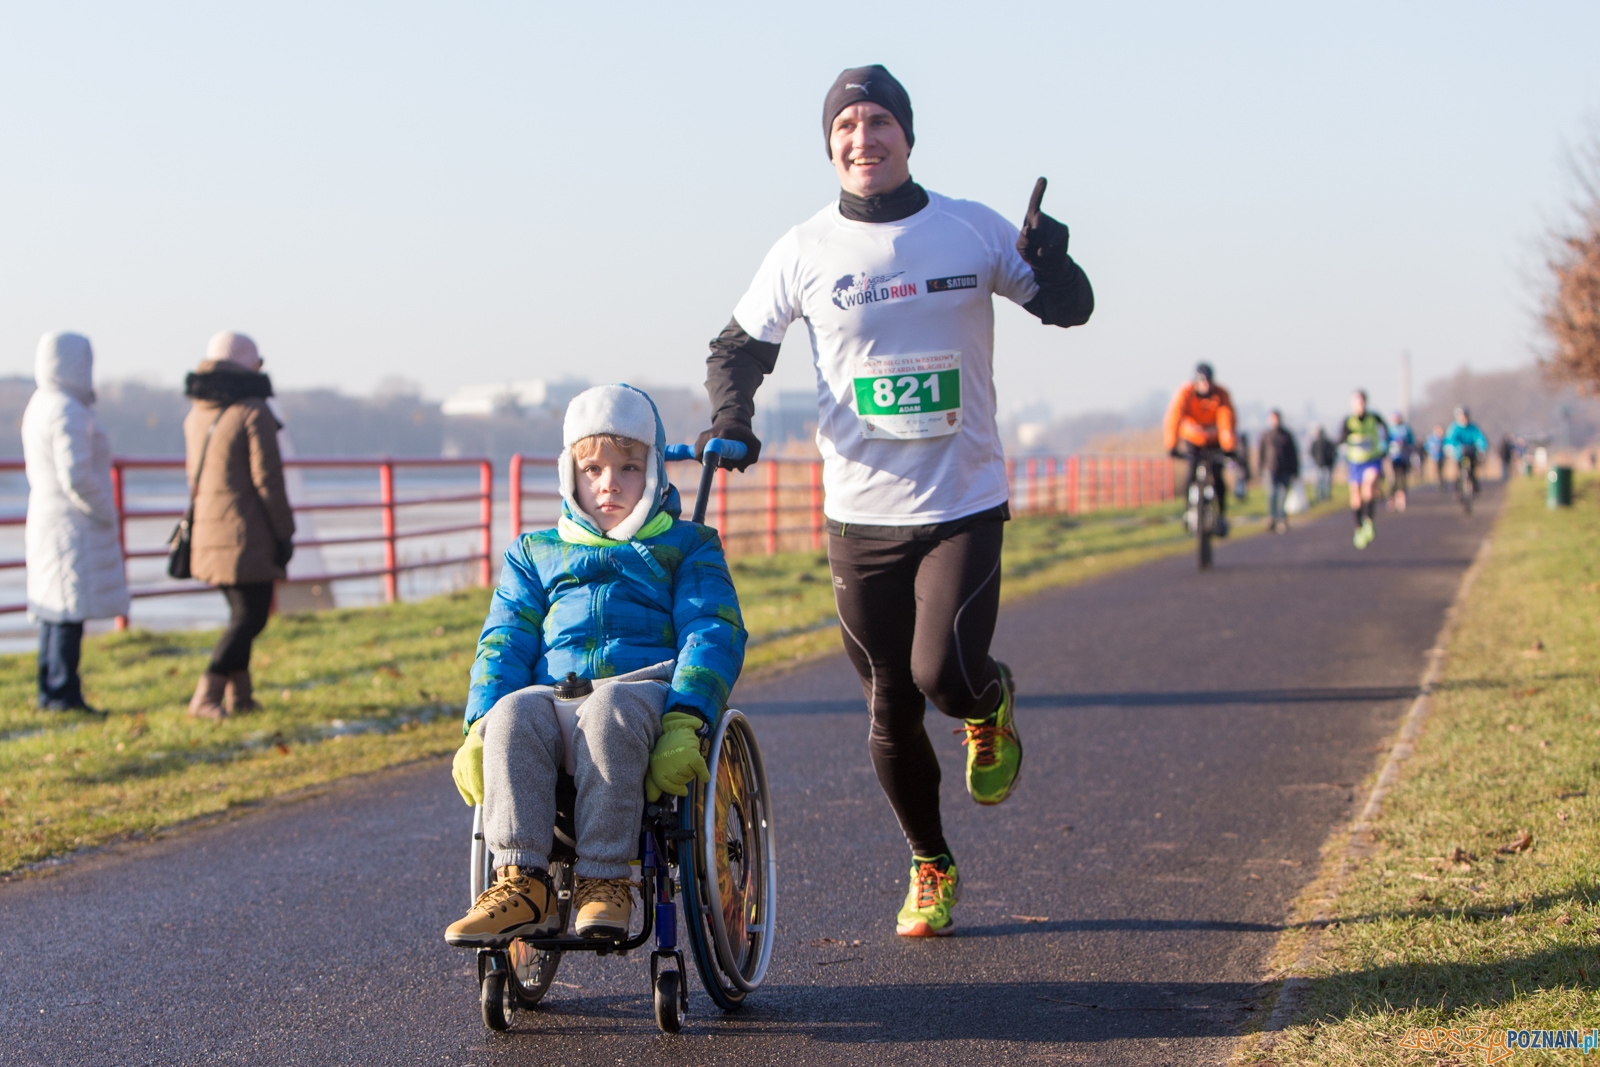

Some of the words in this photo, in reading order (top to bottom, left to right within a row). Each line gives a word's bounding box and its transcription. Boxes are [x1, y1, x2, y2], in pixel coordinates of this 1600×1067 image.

[946, 276, 976, 288] SATURN
[883, 359, 901, 367] BIEG
[902, 353, 954, 365] SYLWESTROWY
[878, 366, 916, 375] RYSZARDA
[917, 362, 953, 371] BURGIELA
[872, 373, 940, 407] 821
[899, 405, 921, 413] ADAM
